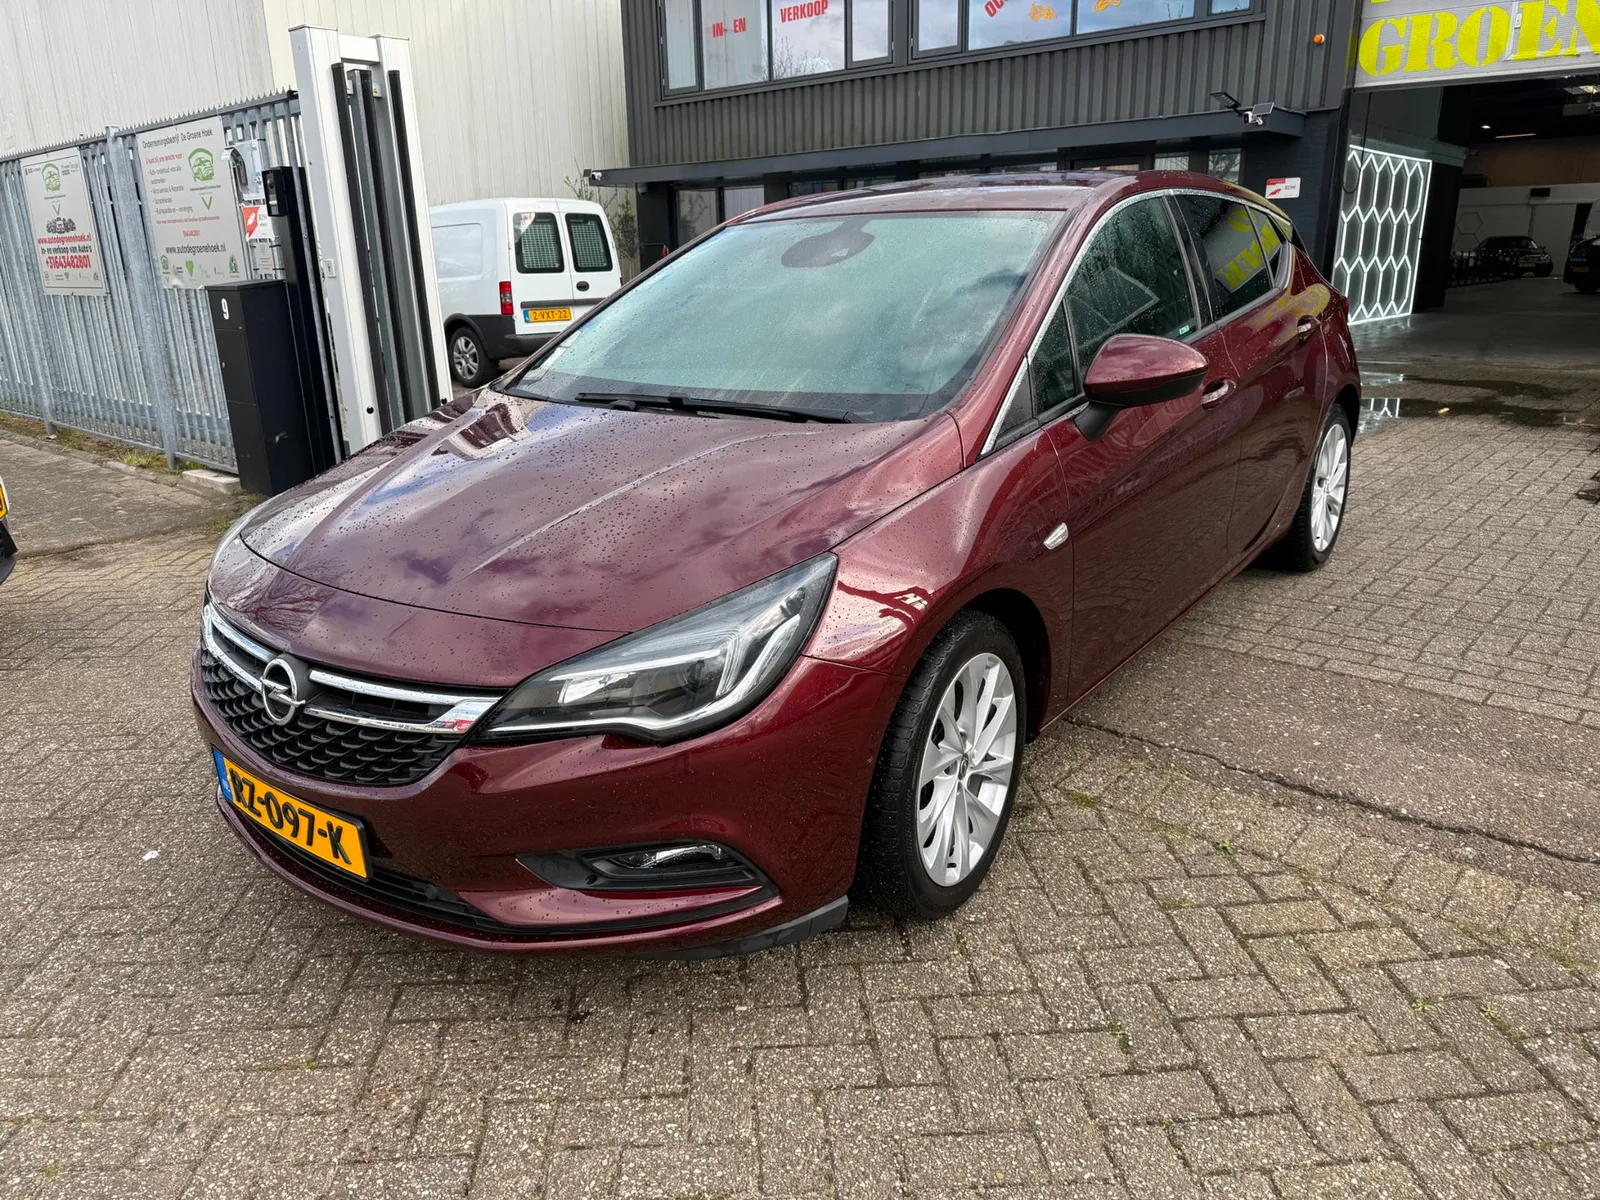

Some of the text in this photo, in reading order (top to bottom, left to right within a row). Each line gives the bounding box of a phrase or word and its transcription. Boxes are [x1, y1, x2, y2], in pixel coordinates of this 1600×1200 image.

[733, 17, 746, 33] EN
[780, 0, 828, 23] VERKOOP
[181, 132, 187, 142] De
[187, 129, 202, 141] Groene
[202, 127, 213, 137] Hoek
[52, 246, 69, 256] verkoop
[165, 242, 227, 256] www.autodegroenehoek.nl
[221, 298, 229, 320] 9
[532, 310, 568, 321] 2-VXT-22
[229, 767, 352, 865] RZ-097-K
